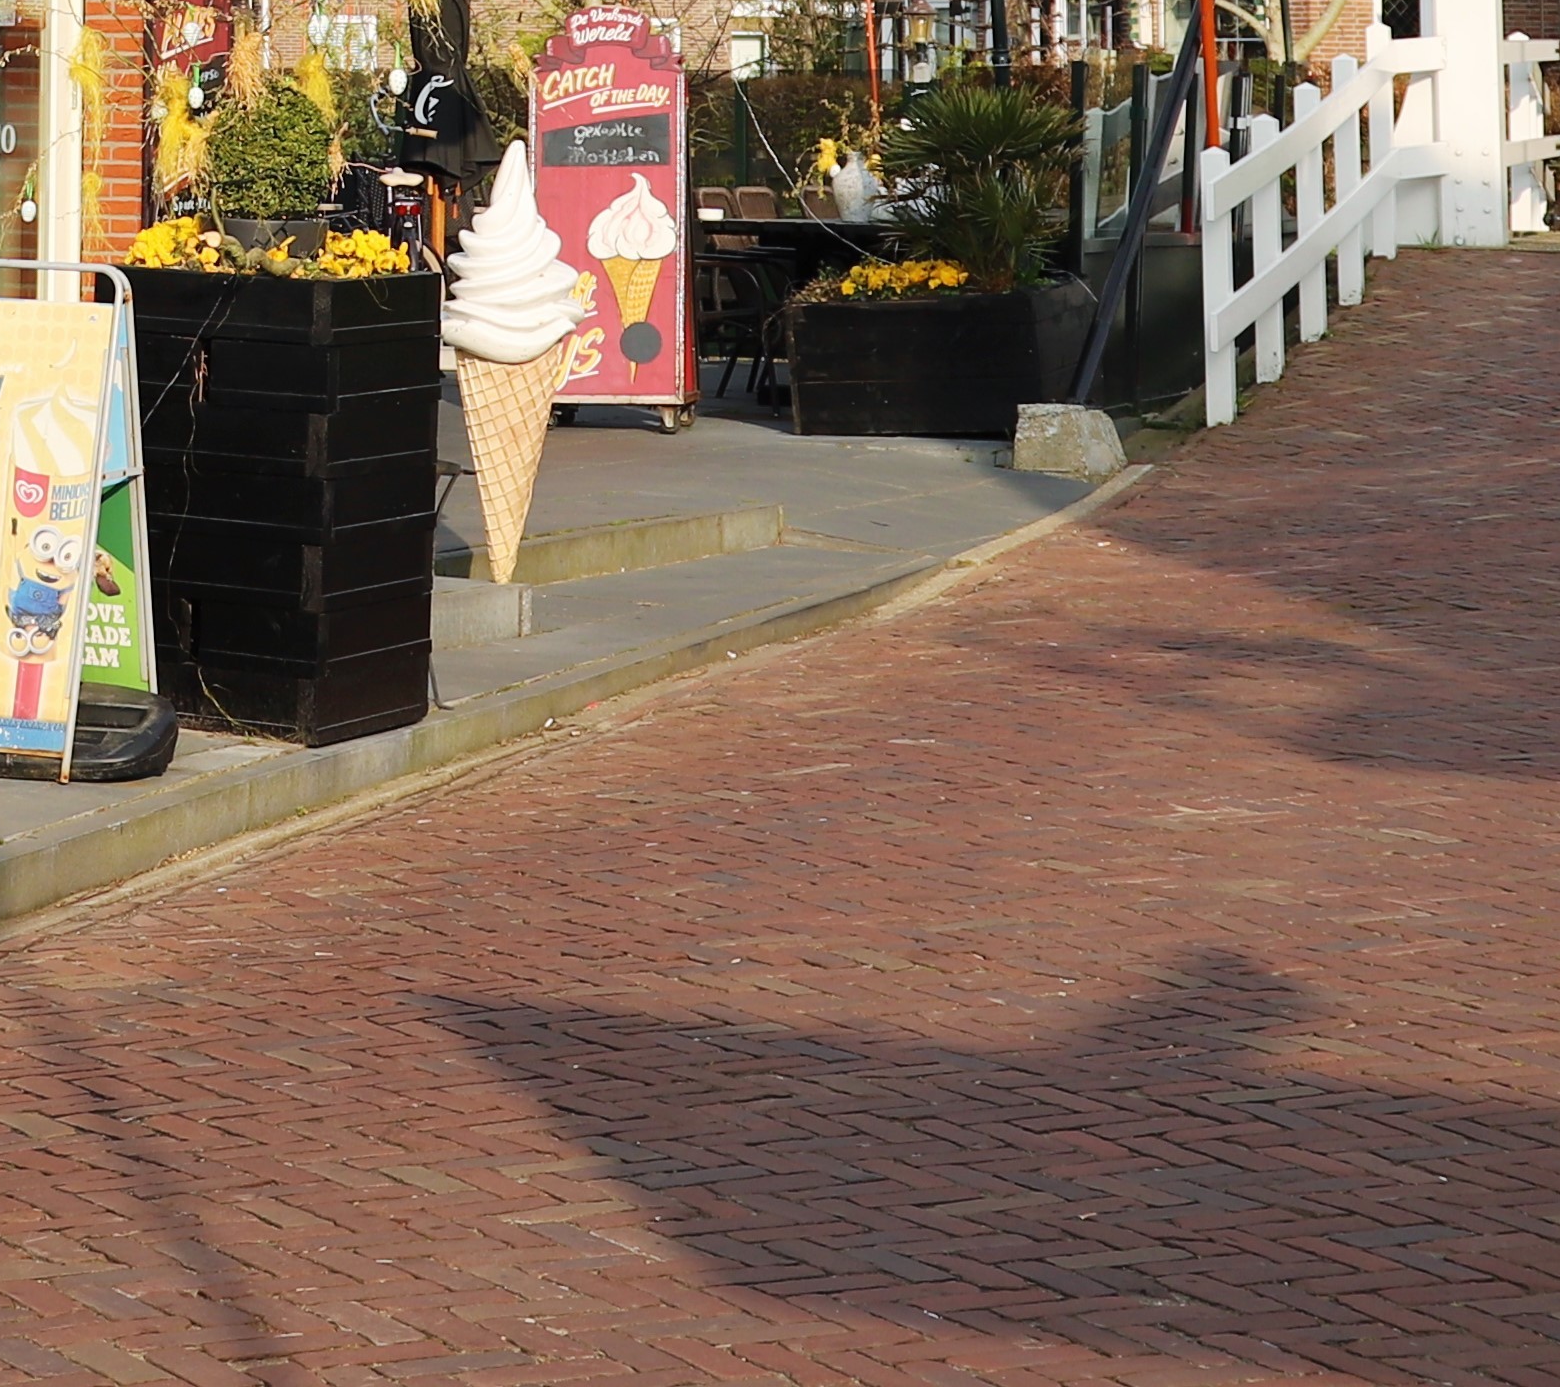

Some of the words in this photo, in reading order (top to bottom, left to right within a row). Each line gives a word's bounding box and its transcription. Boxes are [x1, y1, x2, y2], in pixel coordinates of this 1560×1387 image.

[570, 14, 588, 28] De
[574, 24, 635, 45] Wereld
[542, 63, 615, 101] CATCH
[589, 90, 610, 107] OF
[611, 88, 636, 104] THE
